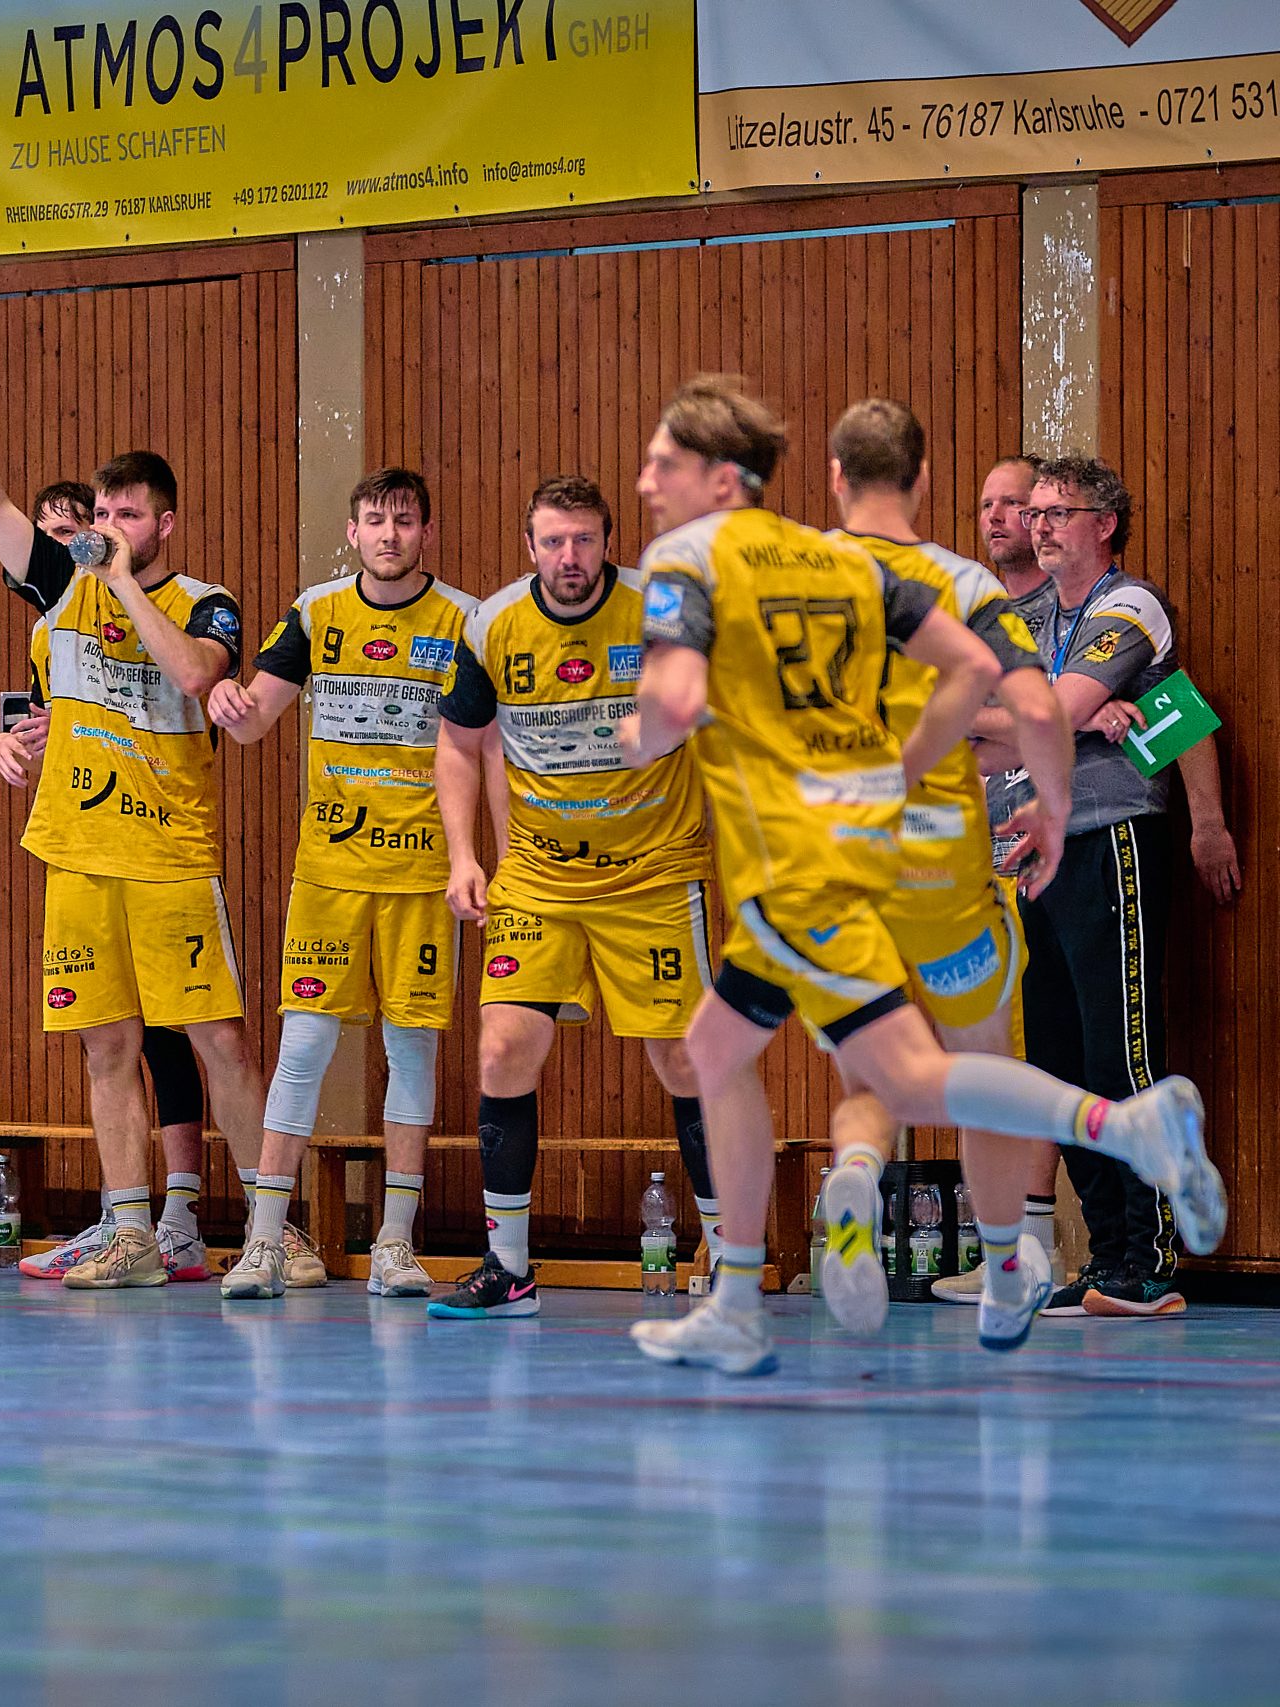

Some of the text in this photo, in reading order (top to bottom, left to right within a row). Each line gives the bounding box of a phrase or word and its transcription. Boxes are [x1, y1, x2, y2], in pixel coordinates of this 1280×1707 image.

[569, 12, 649, 57] GMBH
[728, 110, 858, 151] Litzelaustr.
[867, 105, 895, 142] 45
[920, 101, 1004, 140] 76187
[1014, 95, 1125, 135] Karlsruhe
[1157, 84, 1219, 125] 0721
[1232, 79, 1277, 120] 531
[10, 124, 226, 170] ZU HAUSE SCHAFFEN
[346, 162, 469, 196] www.atmos4.info
[482, 156, 586, 183] info@atmos4.org
[114, 196, 147, 217] 76187
[149, 191, 212, 214] KARLSRUHE
[233, 181, 329, 206] +49 172 6201122
[322, 626, 344, 665] 9
[372, 646, 388, 655] TVK
[413, 645, 451, 661] MERZ
[760, 598, 858, 710] 27
[504, 652, 535, 695] 13
[567, 666, 586, 676] TVK
[319, 702, 353, 710] OLVO
[510, 704, 607, 728] AUTOHAUSGRUPPE
[71, 766, 92, 790] BB
[316, 802, 345, 823] BB
[370, 827, 436, 851] Bank
[510, 930, 543, 942] World
[185, 935, 205, 968] 7
[284, 956, 350, 966] Fitness World
[417, 943, 438, 976] 9
[64, 961, 95, 974] World
[493, 962, 510, 972] TVK
[649, 947, 683, 981] 13
[52, 994, 68, 1002] TVK
[300, 984, 317, 992] TVK
